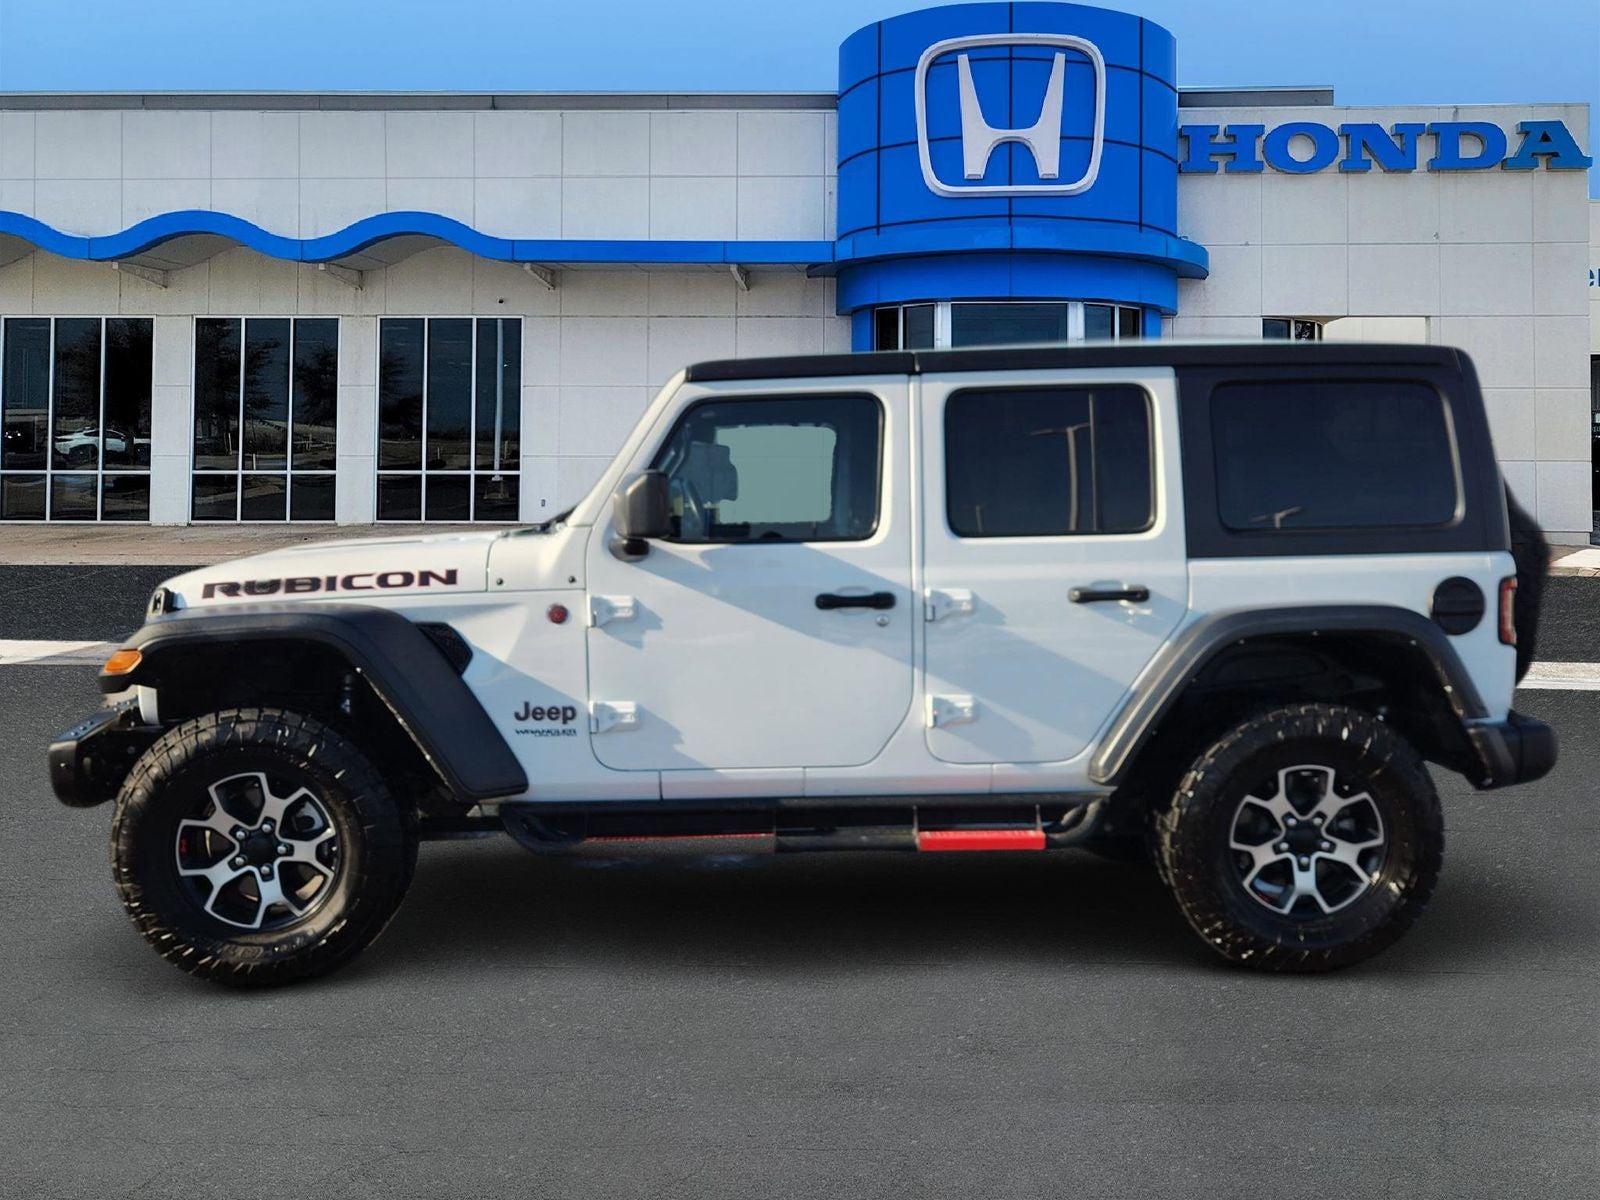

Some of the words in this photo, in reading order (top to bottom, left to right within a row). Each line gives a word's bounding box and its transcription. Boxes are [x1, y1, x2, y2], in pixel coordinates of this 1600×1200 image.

[1180, 121, 1593, 174] HONDA
[202, 569, 458, 599] RUBICON
[514, 701, 577, 725] Jeep
